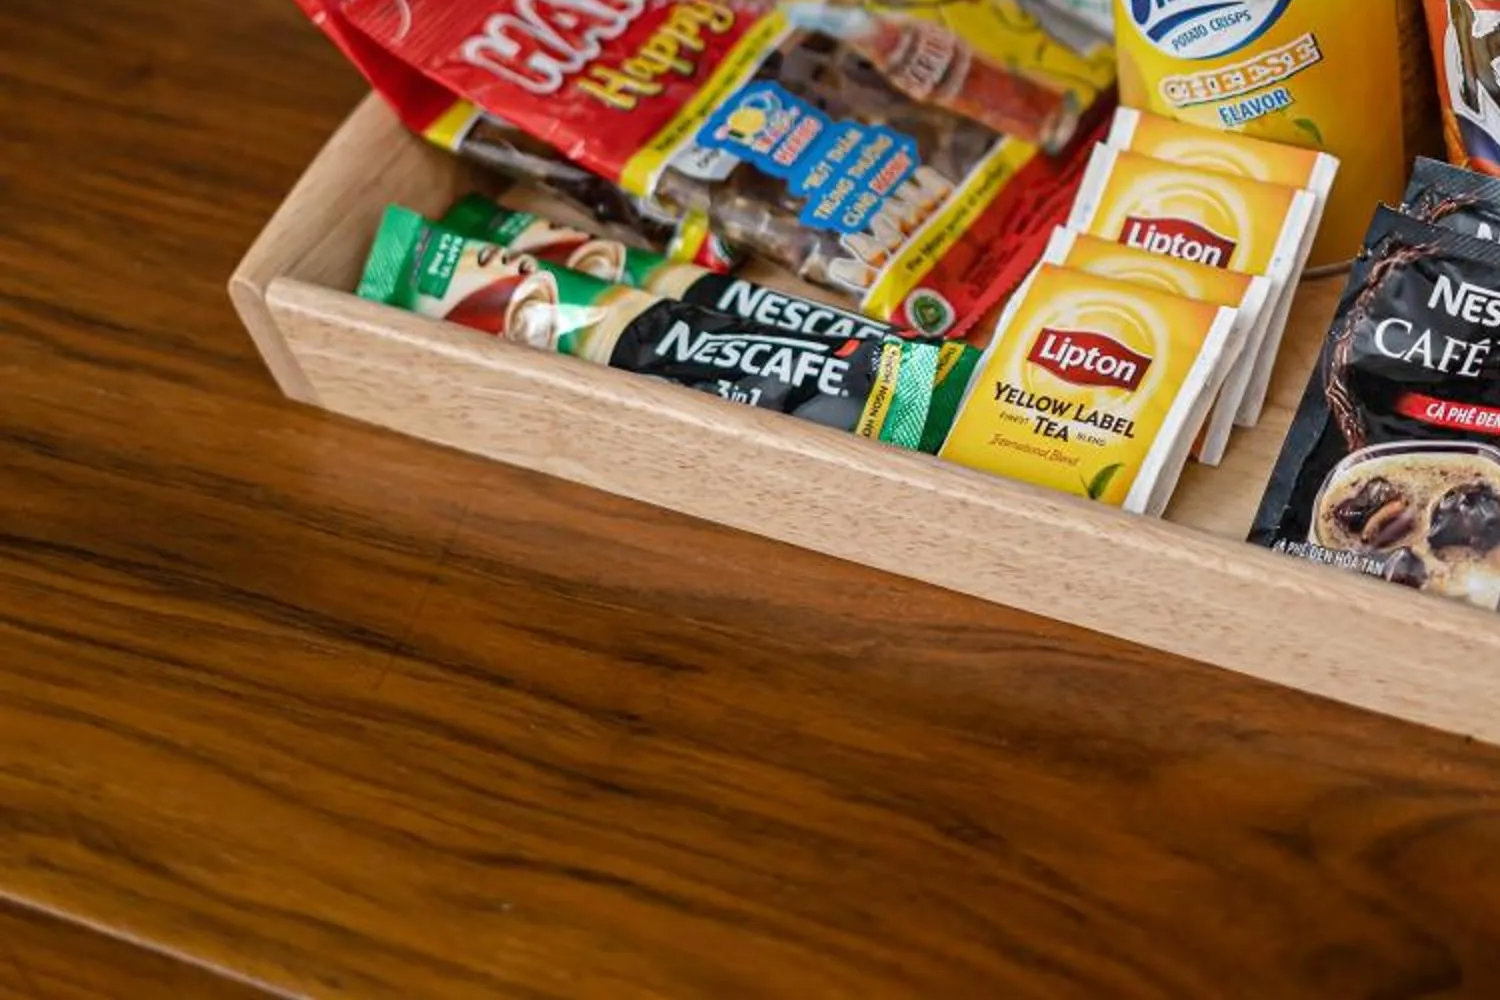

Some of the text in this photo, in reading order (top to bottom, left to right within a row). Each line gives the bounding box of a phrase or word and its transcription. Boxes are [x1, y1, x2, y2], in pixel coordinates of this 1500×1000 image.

[1171, 9, 1252, 50] POTATO CRISPS
[1162, 35, 1321, 103] CHEESE
[1219, 89, 1293, 126] FLAVOR
[1127, 220, 1222, 267] Lipton
[717, 280, 900, 342] NESCA
[1039, 333, 1137, 382] Lipton
[1374, 317, 1491, 377] CAFÉ
[993, 381, 1136, 439] YELLOW LABEL
[1032, 415, 1069, 442] TEA
[1446, 406, 1476, 425] PHÊ
[1361, 558, 1386, 575] TAN
